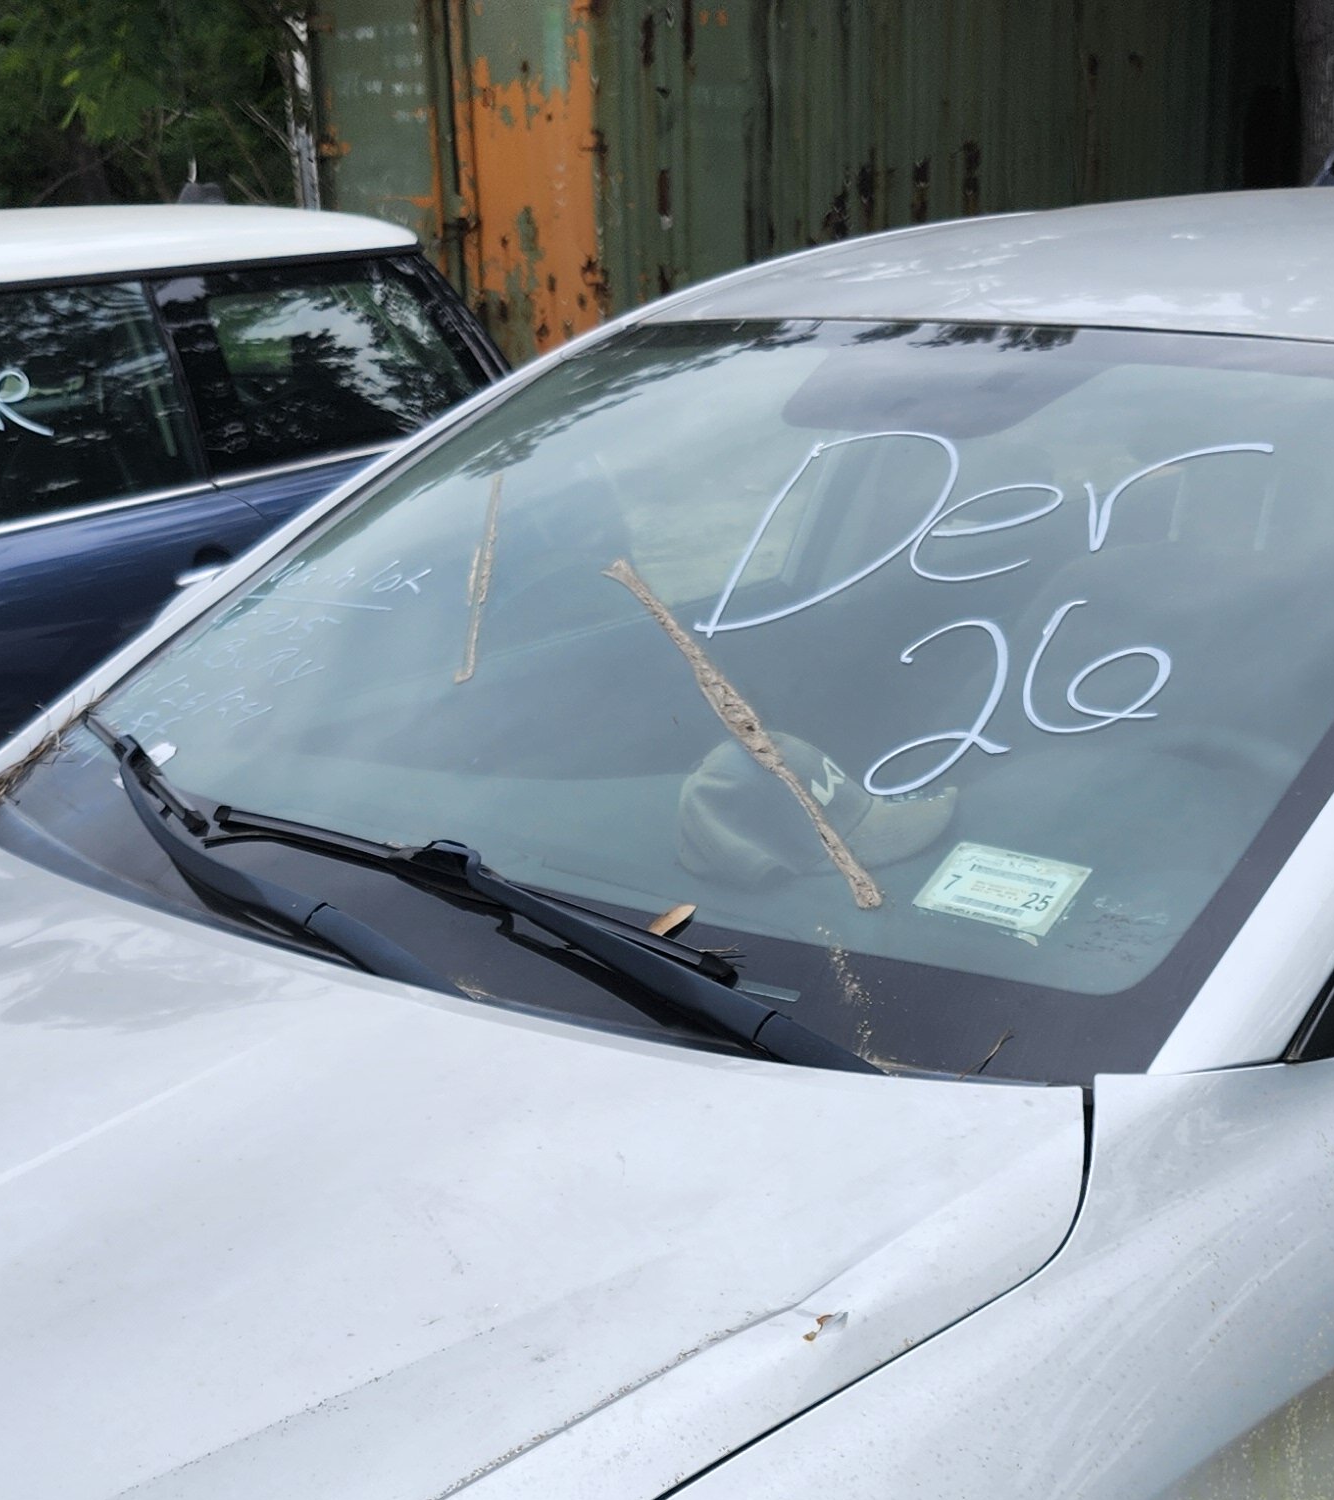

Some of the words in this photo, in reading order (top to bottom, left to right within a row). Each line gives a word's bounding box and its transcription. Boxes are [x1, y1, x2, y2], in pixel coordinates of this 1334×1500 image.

[693, 430, 1274, 638] Der
[863, 600, 1173, 797] 26
[943, 874, 963, 891] 7
[1020, 892, 1054, 912] 25
